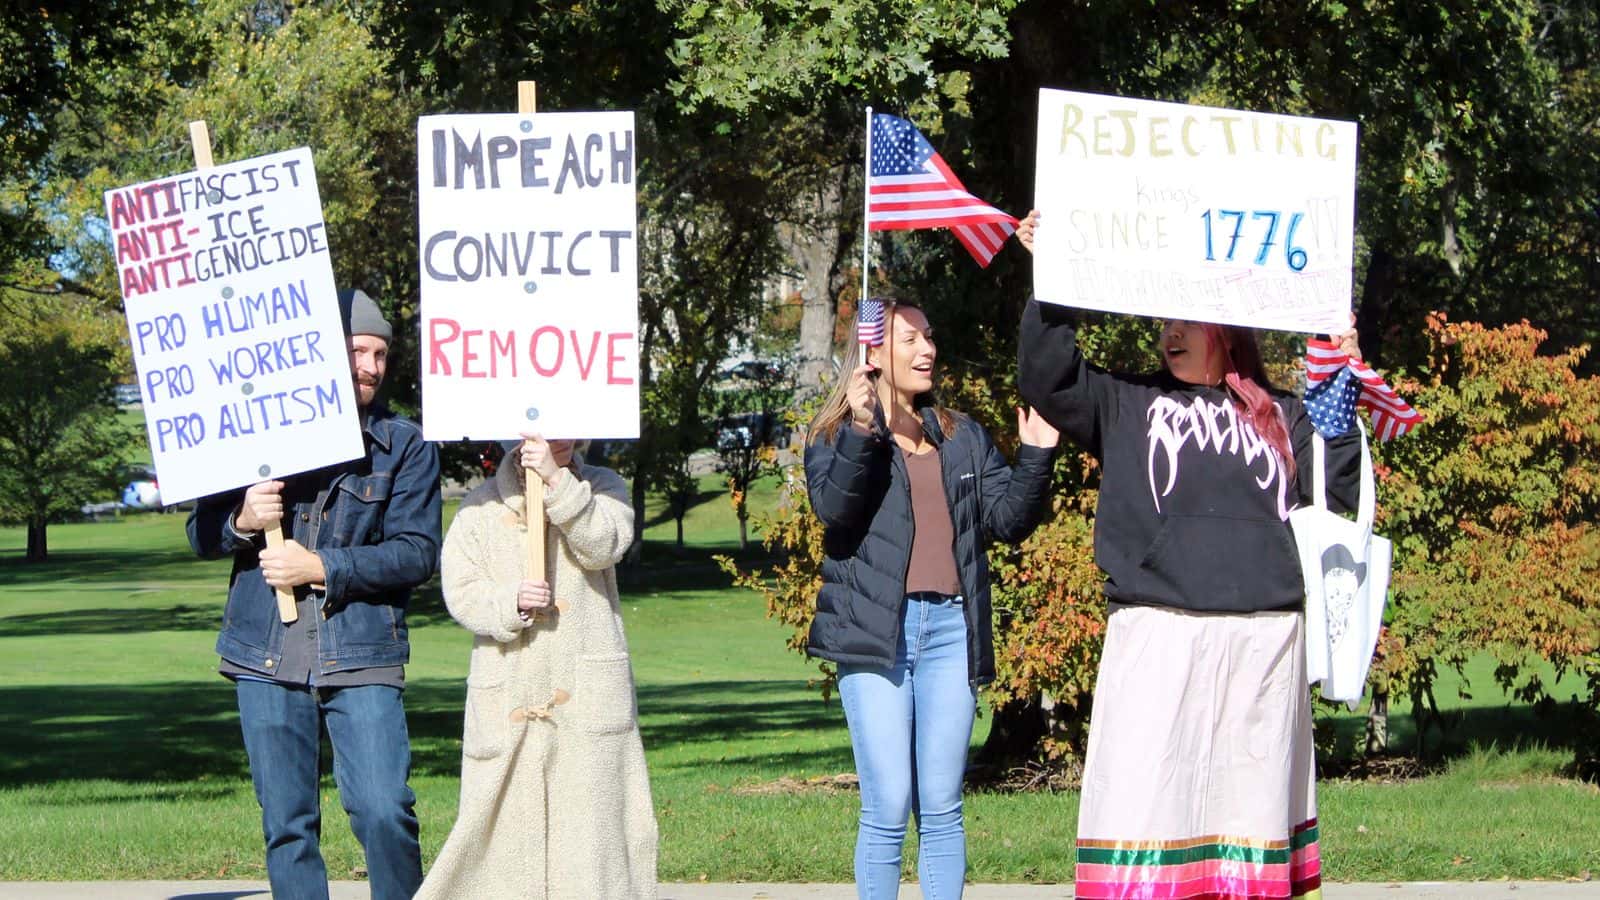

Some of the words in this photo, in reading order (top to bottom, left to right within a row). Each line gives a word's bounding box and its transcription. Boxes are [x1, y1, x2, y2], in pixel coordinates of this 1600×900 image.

[431, 126, 633, 194] IMPEACH
[1060, 103, 1337, 162] REJECTING
[116, 219, 200, 264] ANTI-
[207, 205, 271, 243] ICE
[424, 230, 632, 282] CONVICT
[1068, 208, 1169, 254] SINCE
[136, 312, 187, 356] PRO
[201, 279, 312, 338] HUMAN
[146, 364, 195, 403] PRO
[209, 330, 325, 387] WORKER
[429, 318, 634, 385] REMOVE
[155, 412, 205, 453] PRO
[218, 379, 343, 439] AUTISM
